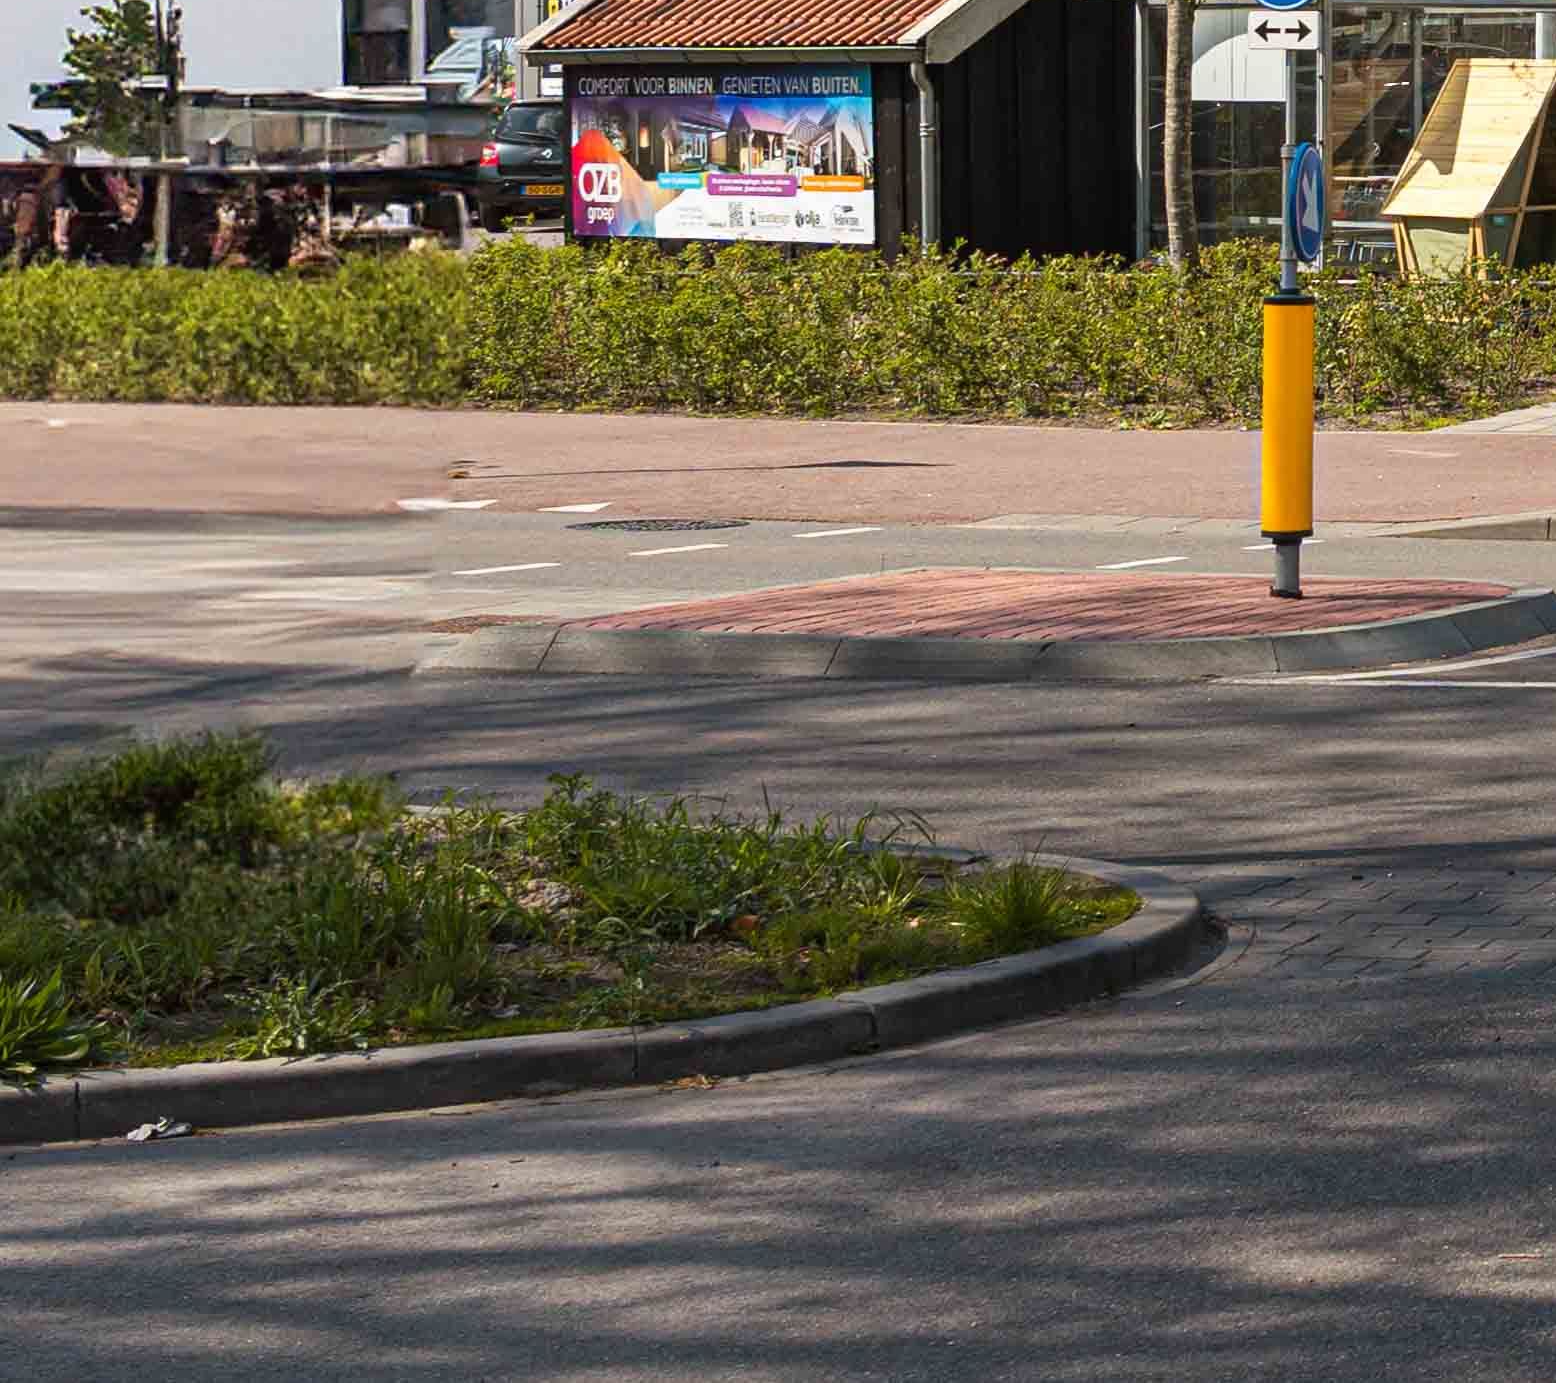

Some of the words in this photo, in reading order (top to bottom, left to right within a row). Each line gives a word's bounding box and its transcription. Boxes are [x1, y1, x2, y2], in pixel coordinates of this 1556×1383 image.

[578, 76, 630, 95] COMFORT
[633, 76, 664, 95] VOOR
[722, 76, 781, 94] GENIETEN
[783, 76, 809, 94] VAN
[812, 76, 863, 94] BUITEN.
[578, 162, 622, 203] OZB
[587, 205, 615, 225] groep
